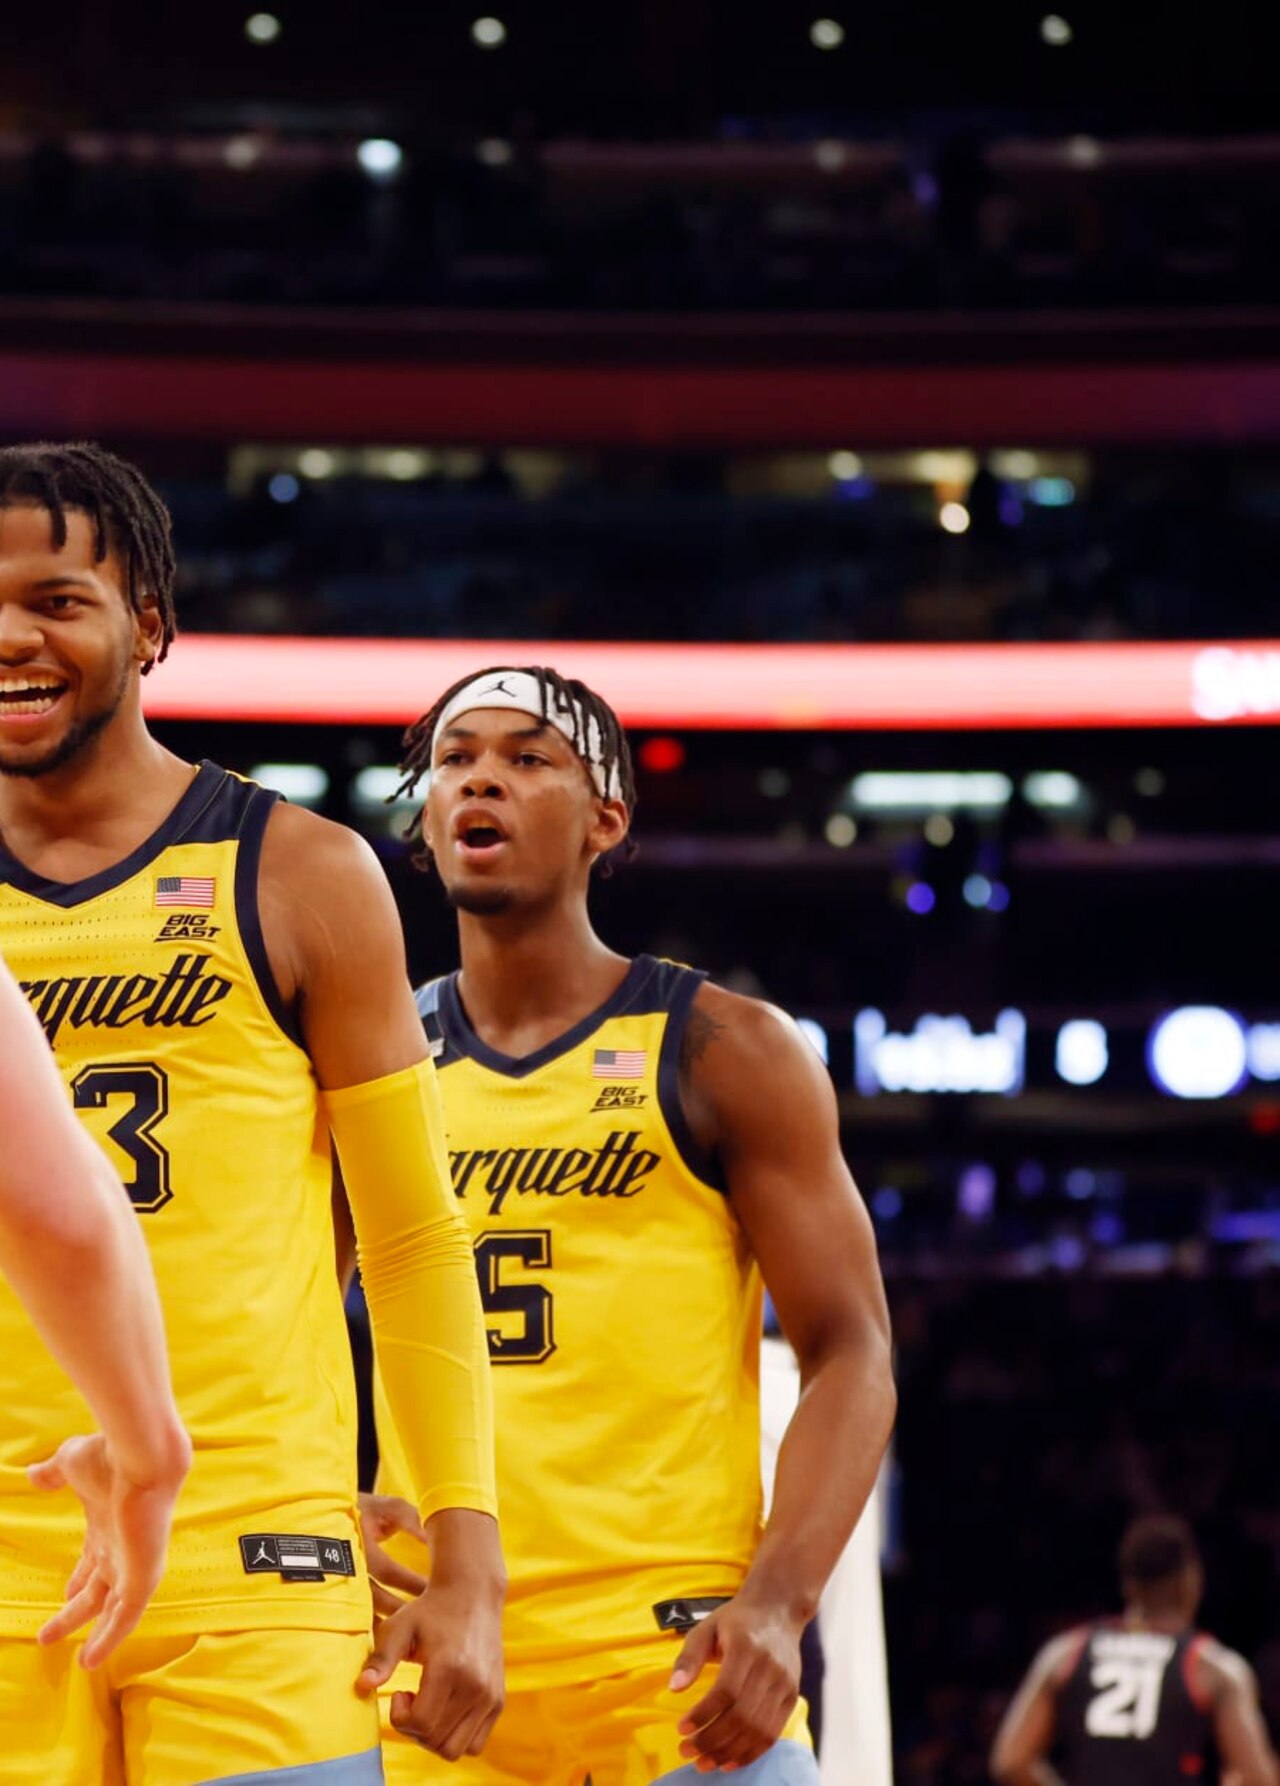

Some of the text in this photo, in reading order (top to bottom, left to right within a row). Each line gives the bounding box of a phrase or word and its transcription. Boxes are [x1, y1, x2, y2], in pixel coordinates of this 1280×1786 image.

[166, 914, 210, 926] BIG
[159, 926, 222, 938] EAST
[600, 1086, 639, 1097] BIG
[595, 1095, 648, 1107] EAST
[473, 1230, 557, 1365] 5
[324, 1547, 340, 1563] 48
[1085, 1659, 1166, 1740] 21
